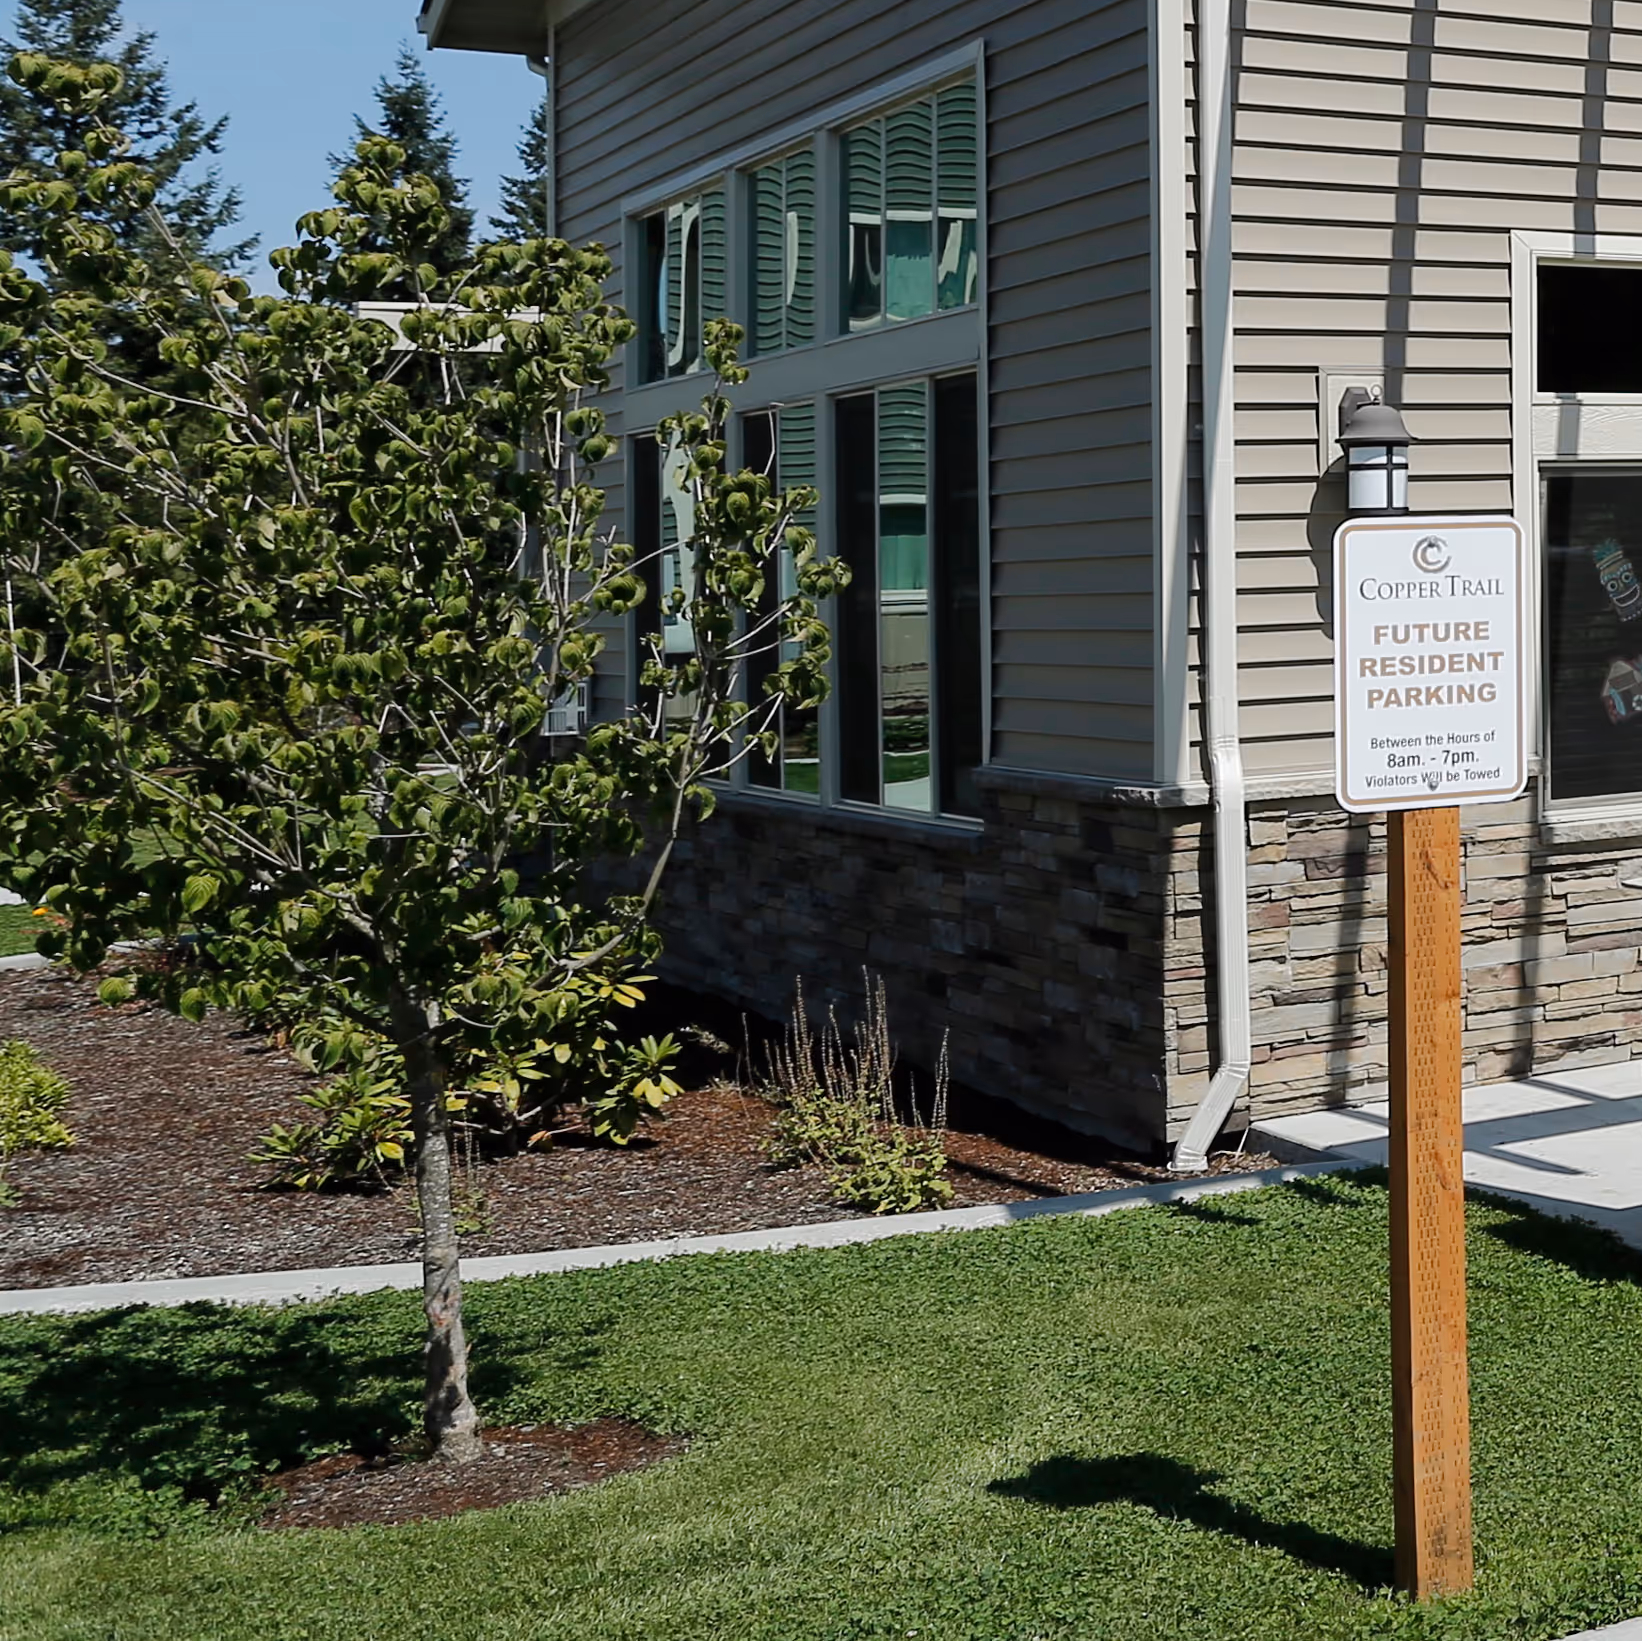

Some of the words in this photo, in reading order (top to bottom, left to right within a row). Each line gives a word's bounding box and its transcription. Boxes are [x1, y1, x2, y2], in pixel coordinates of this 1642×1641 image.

[1360, 578, 1443, 601] COPPER
[1445, 575, 1504, 597] TRAIL
[1373, 620, 1490, 646] FUTURE
[1359, 651, 1505, 679] RESIDENT
[1367, 682, 1497, 709] PARKING
[1370, 736, 1421, 750] Between
[1425, 734, 1444, 746] the
[1447, 732, 1481, 744] Hours
[1484, 729, 1496, 742] of
[1387, 753, 1426, 768] 8am.
[1442, 749, 1480, 767] 7pm.
[1365, 775, 1418, 788] Violators
[1446, 770, 1460, 782] be
[1464, 767, 1501, 781] Towed
